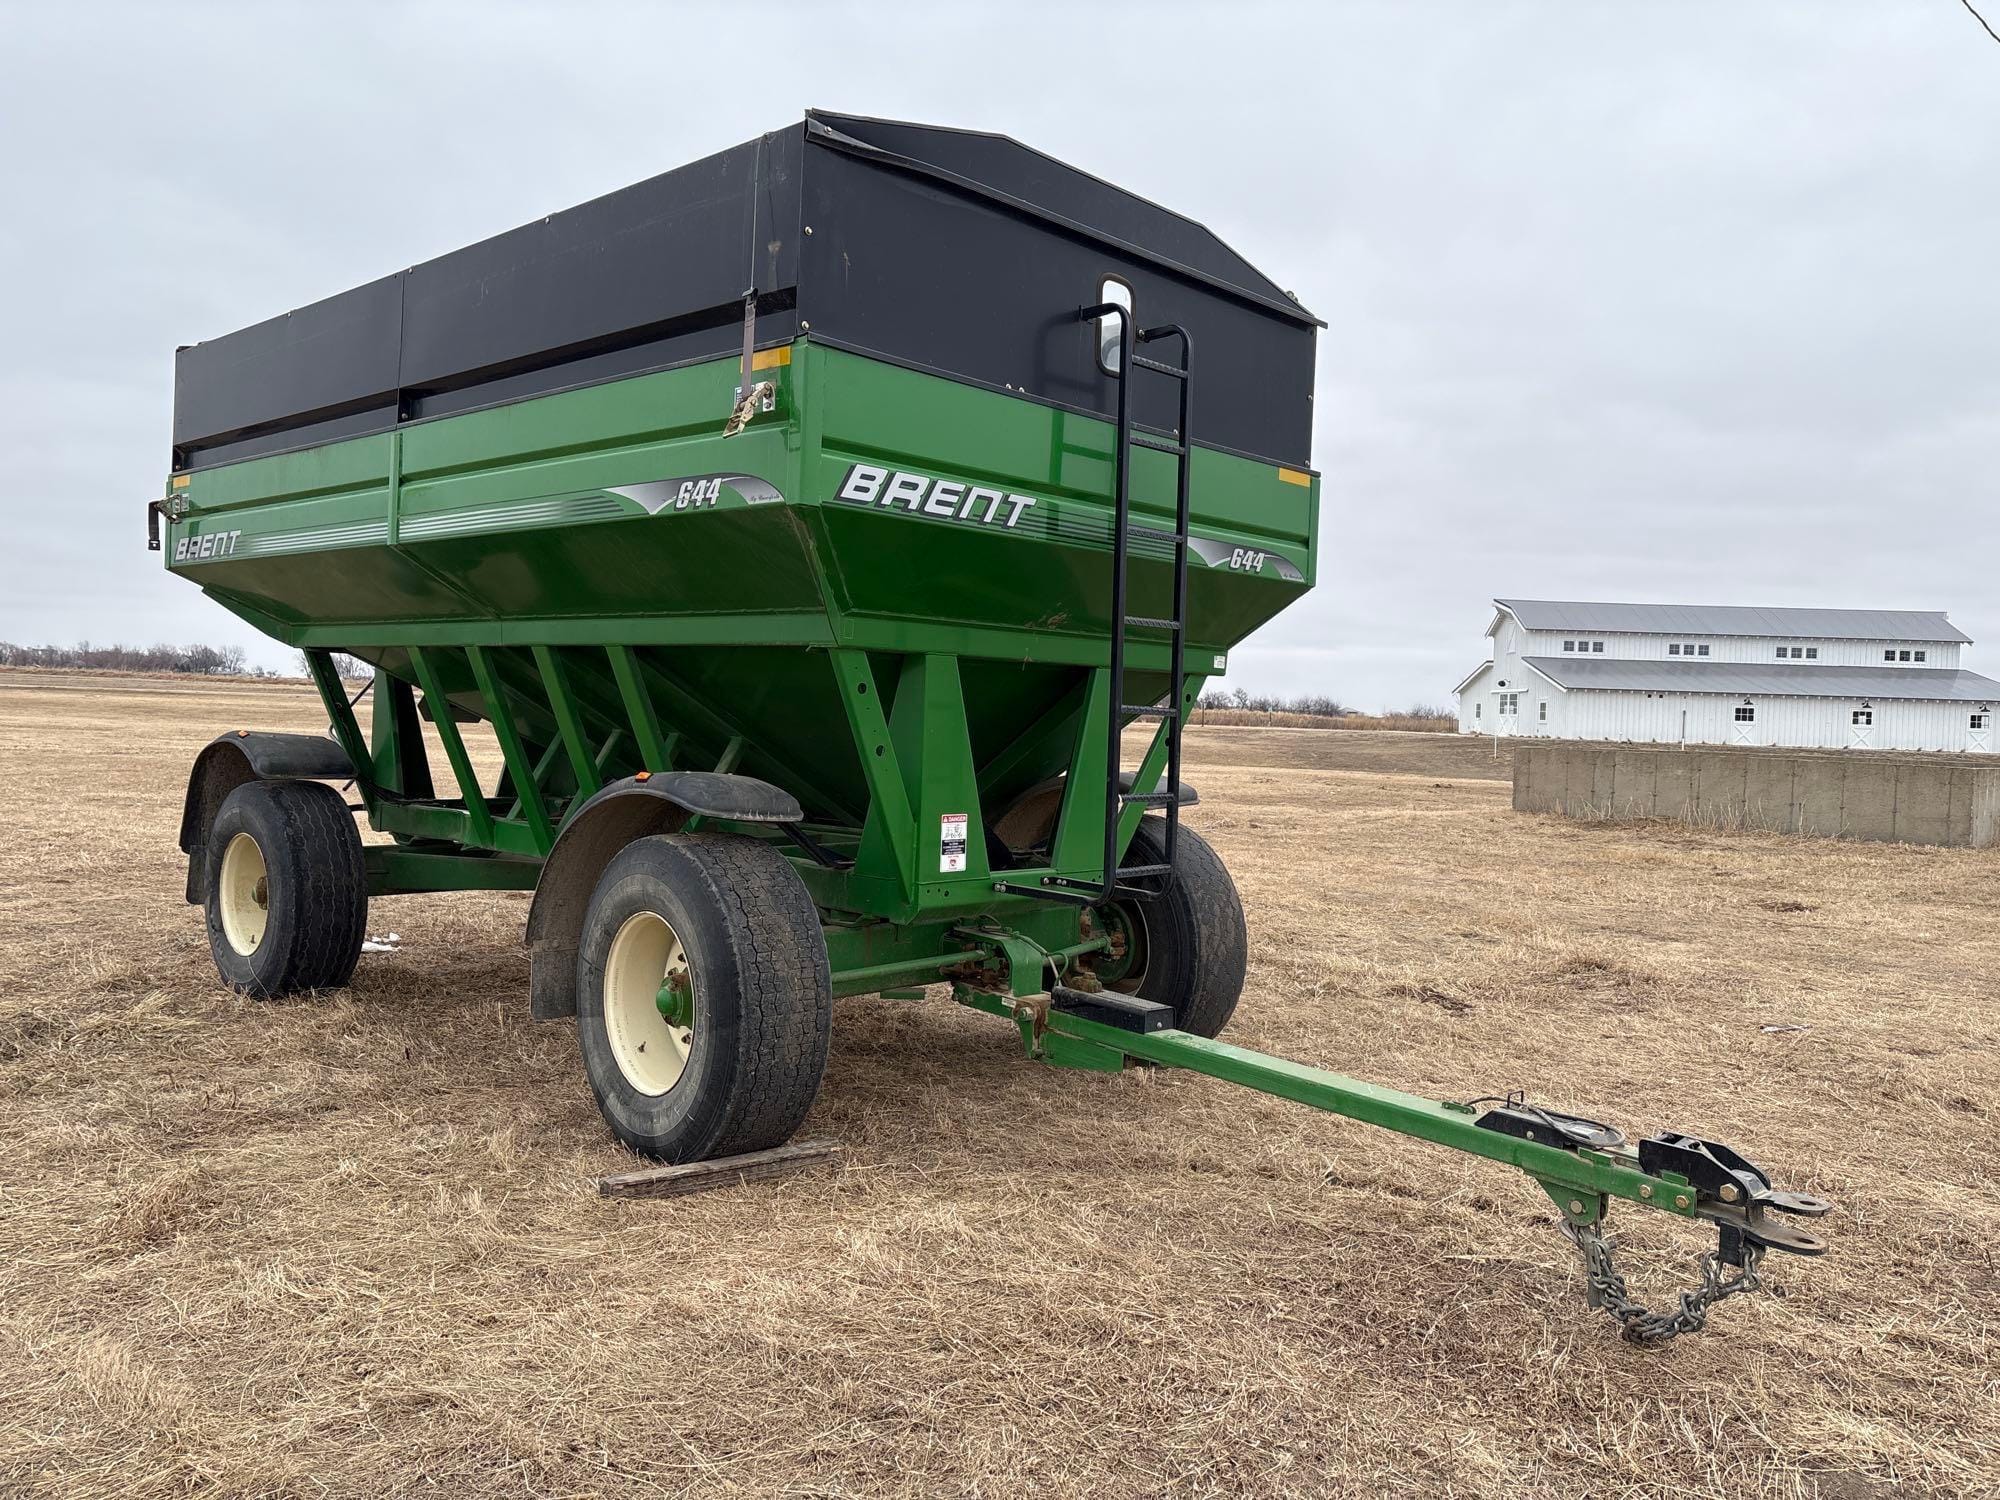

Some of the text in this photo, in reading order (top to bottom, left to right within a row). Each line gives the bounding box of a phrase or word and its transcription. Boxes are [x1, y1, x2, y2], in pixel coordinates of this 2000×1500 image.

[675, 478, 722, 510] 644
[837, 463, 1037, 527] BRENT
[175, 530, 242, 562] BRENT
[1230, 548, 1265, 573] 644
